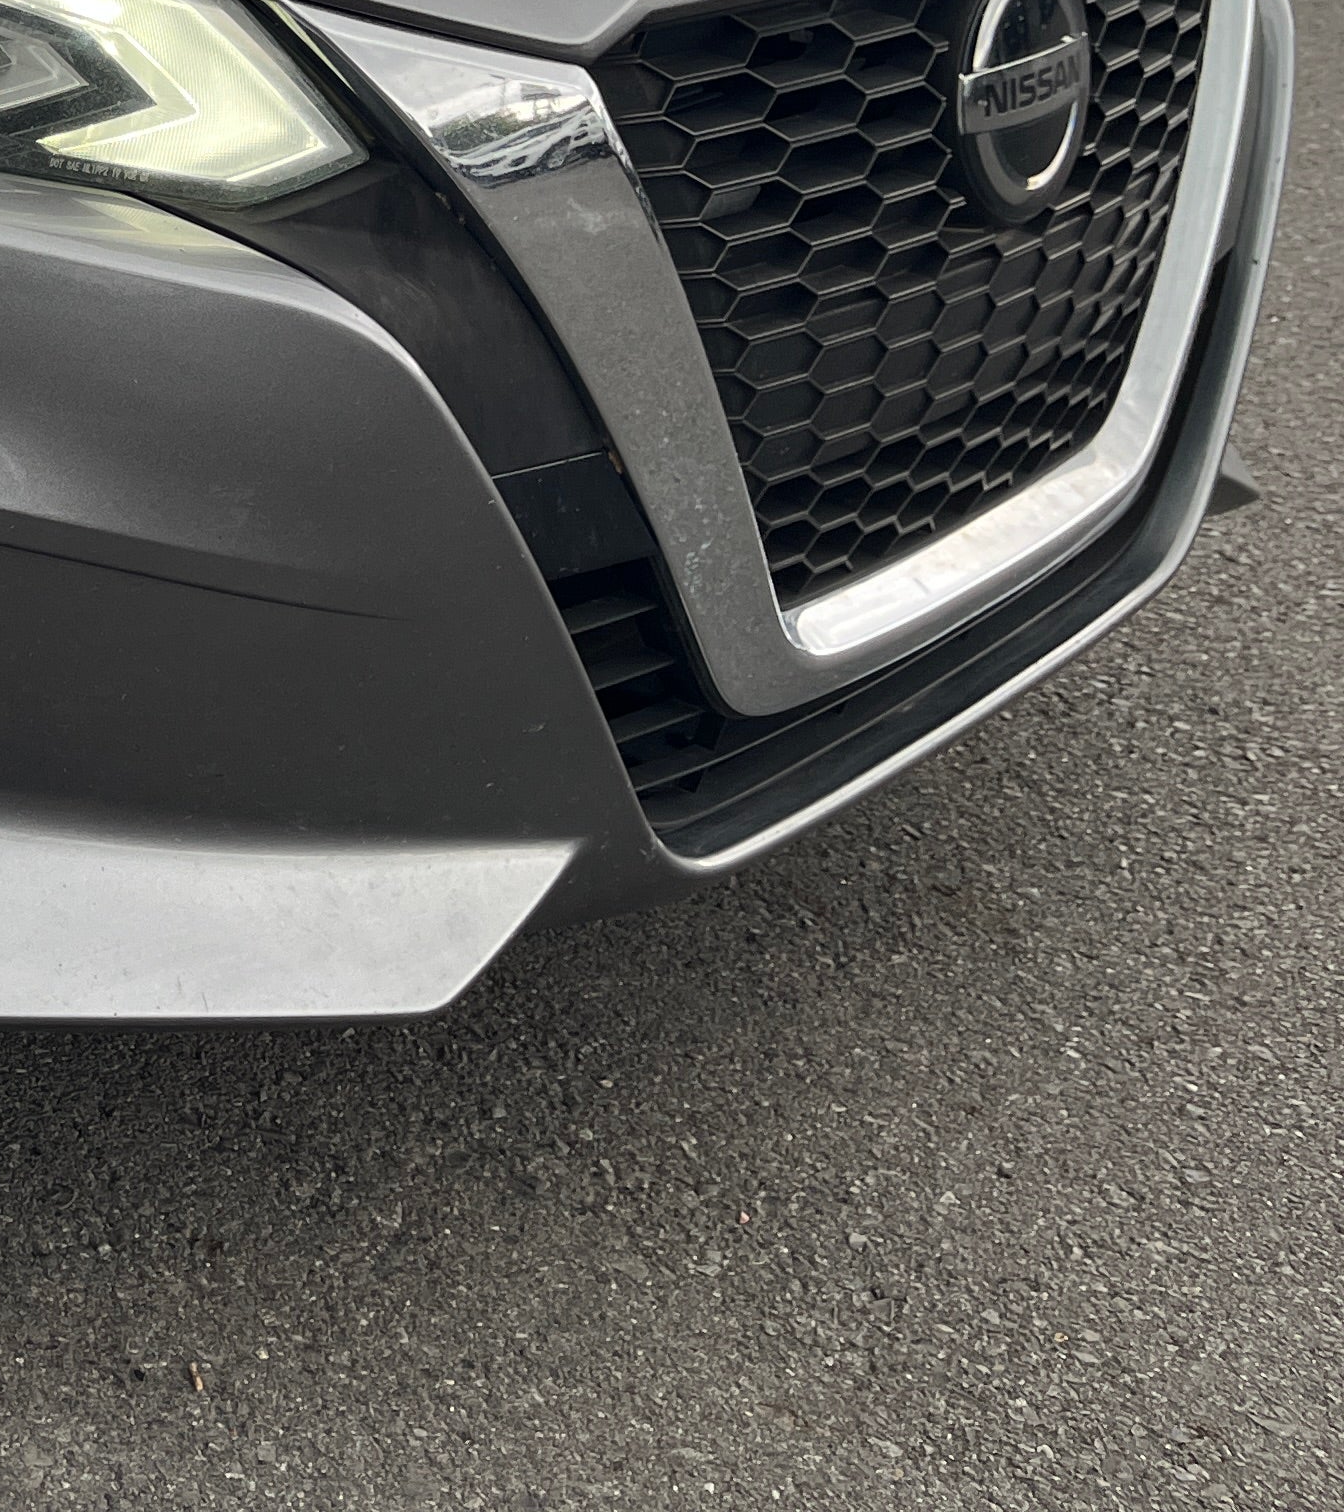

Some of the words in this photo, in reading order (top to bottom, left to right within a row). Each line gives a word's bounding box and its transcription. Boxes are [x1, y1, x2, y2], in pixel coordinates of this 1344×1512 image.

[984, 54, 1082, 117] NISSAN
[49, 157, 65, 169] DOT
[65, 159, 80, 172] SAE
